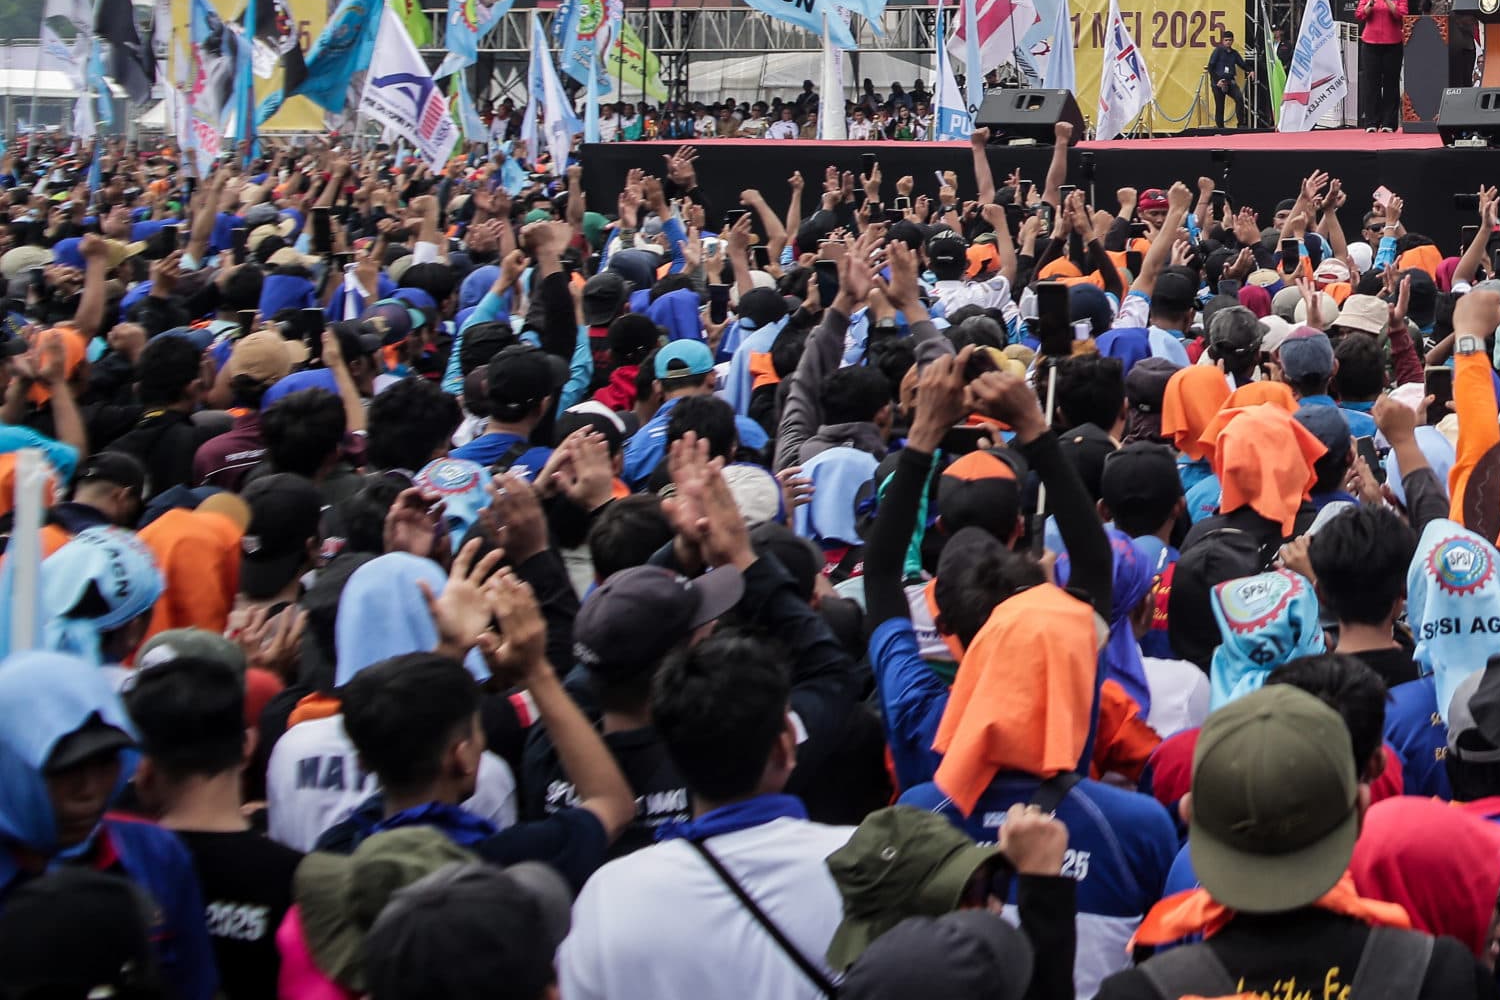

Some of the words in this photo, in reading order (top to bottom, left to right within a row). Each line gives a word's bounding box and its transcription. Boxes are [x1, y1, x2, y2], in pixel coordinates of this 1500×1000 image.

[1152, 11, 1226, 48] 2025
[1450, 552, 1472, 566] SPSI
[1420, 616, 1461, 640] SSI
